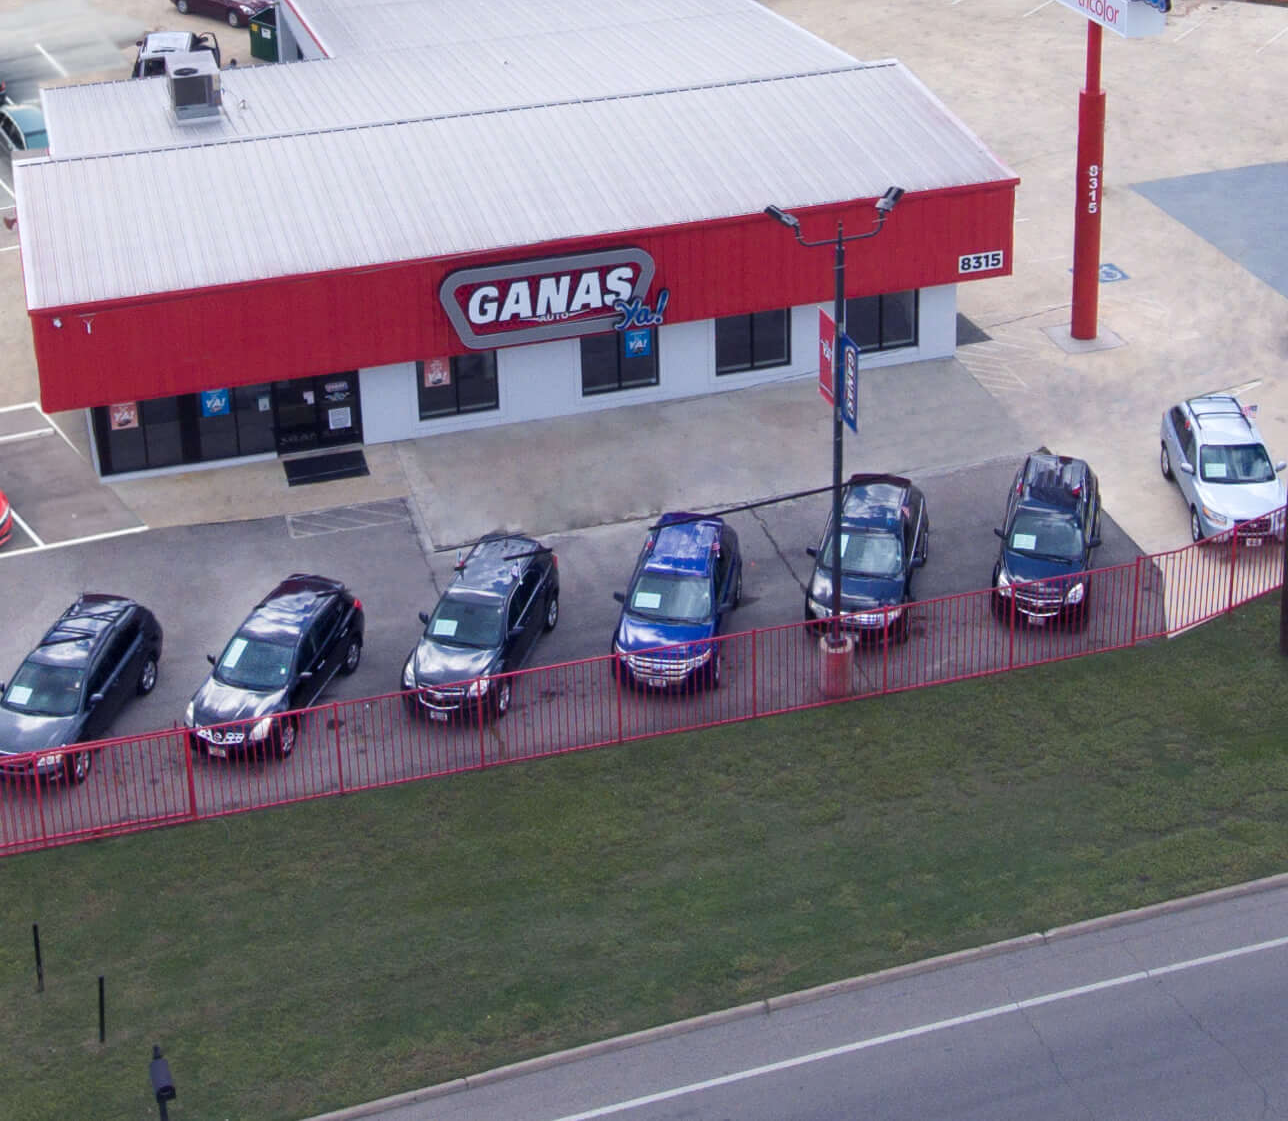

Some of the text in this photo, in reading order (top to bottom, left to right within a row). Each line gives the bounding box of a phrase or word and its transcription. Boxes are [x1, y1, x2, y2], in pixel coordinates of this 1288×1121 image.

[1088, 165, 1098, 214] 8315
[961, 253, 1001, 271] 8315
[468, 266, 634, 325] GANAS
[615, 289, 670, 330] Ya!
[540, 312, 569, 322] AUTO
